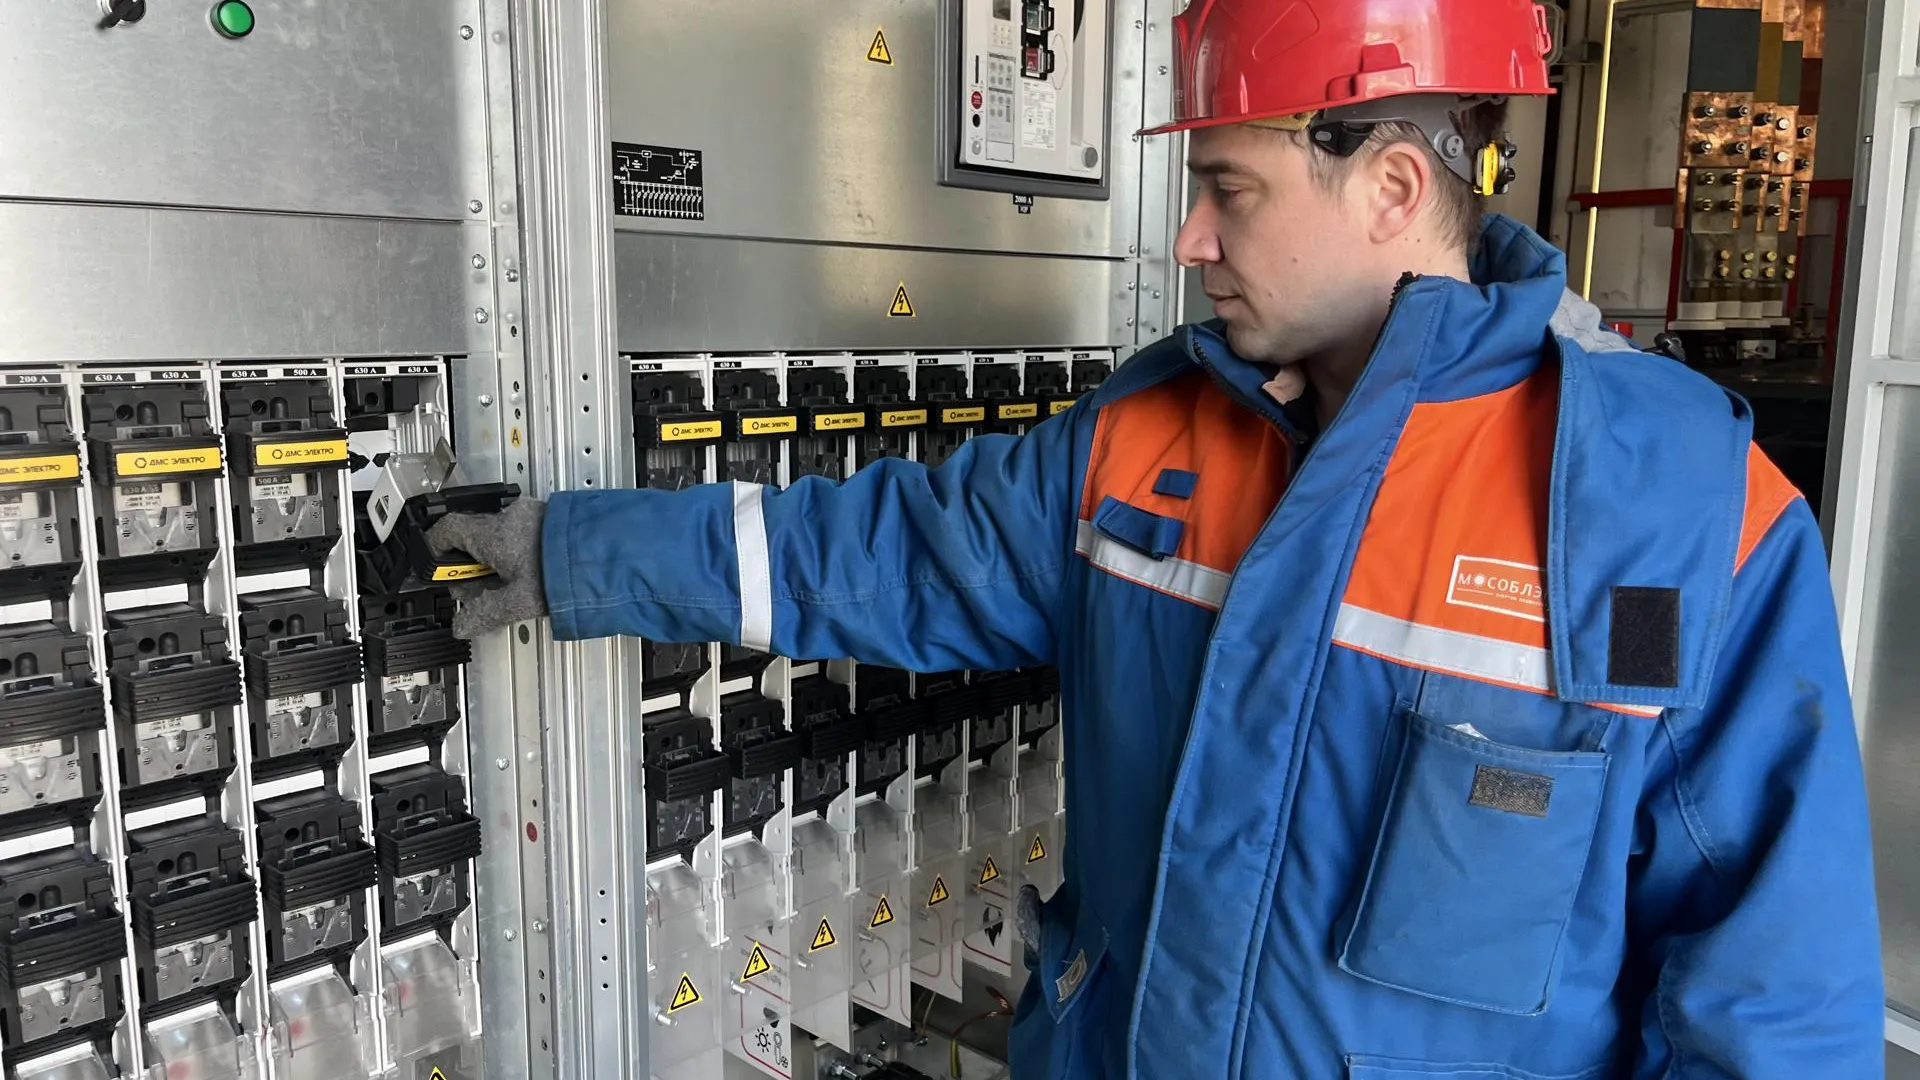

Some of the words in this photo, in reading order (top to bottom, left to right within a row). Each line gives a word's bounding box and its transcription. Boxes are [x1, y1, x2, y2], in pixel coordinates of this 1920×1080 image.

[95, 374, 113, 382] 630
[231, 370, 248, 378] 630
[285, 449, 302, 458] ДМС
[304, 448, 334, 456] ЭЛЕКТРО
[149, 458, 168, 466] ДМС
[171, 456, 206, 465] ЭЛЕКТРО
